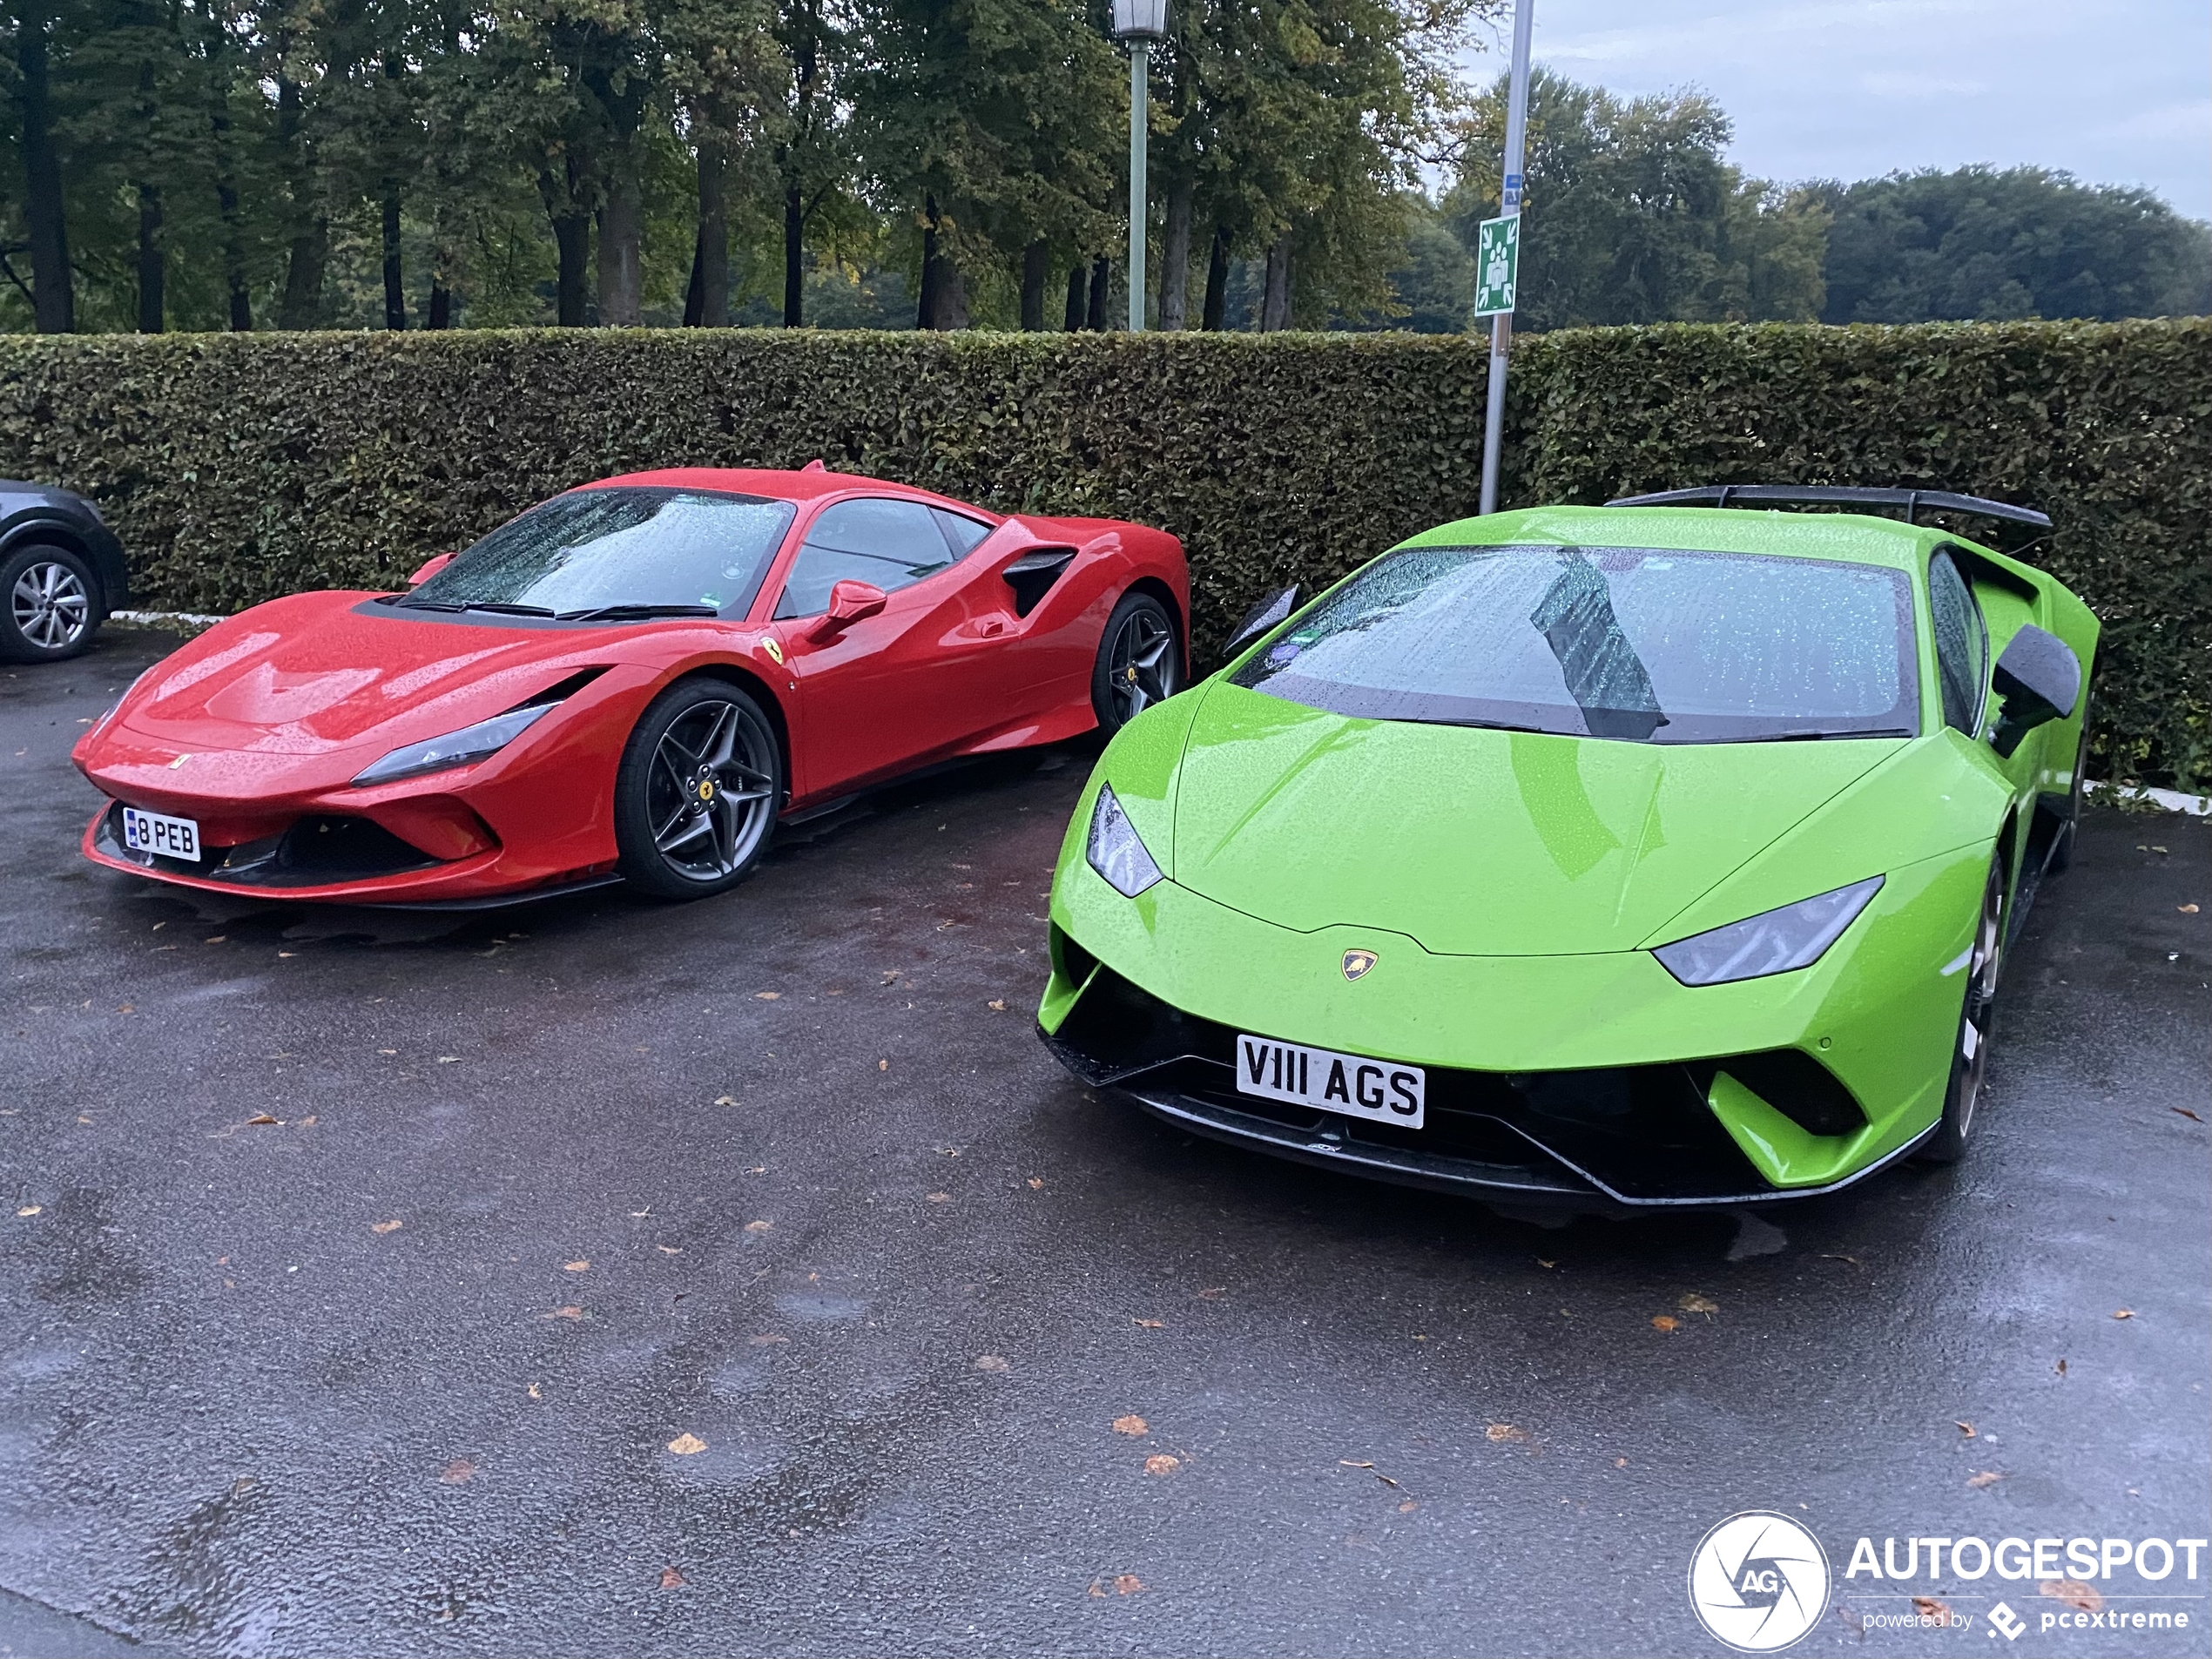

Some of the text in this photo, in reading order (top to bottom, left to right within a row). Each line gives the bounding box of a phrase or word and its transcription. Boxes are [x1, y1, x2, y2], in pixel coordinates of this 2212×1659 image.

[138, 818, 193, 853] 8 PEB
[1324, 1058, 1419, 1116] AGS
